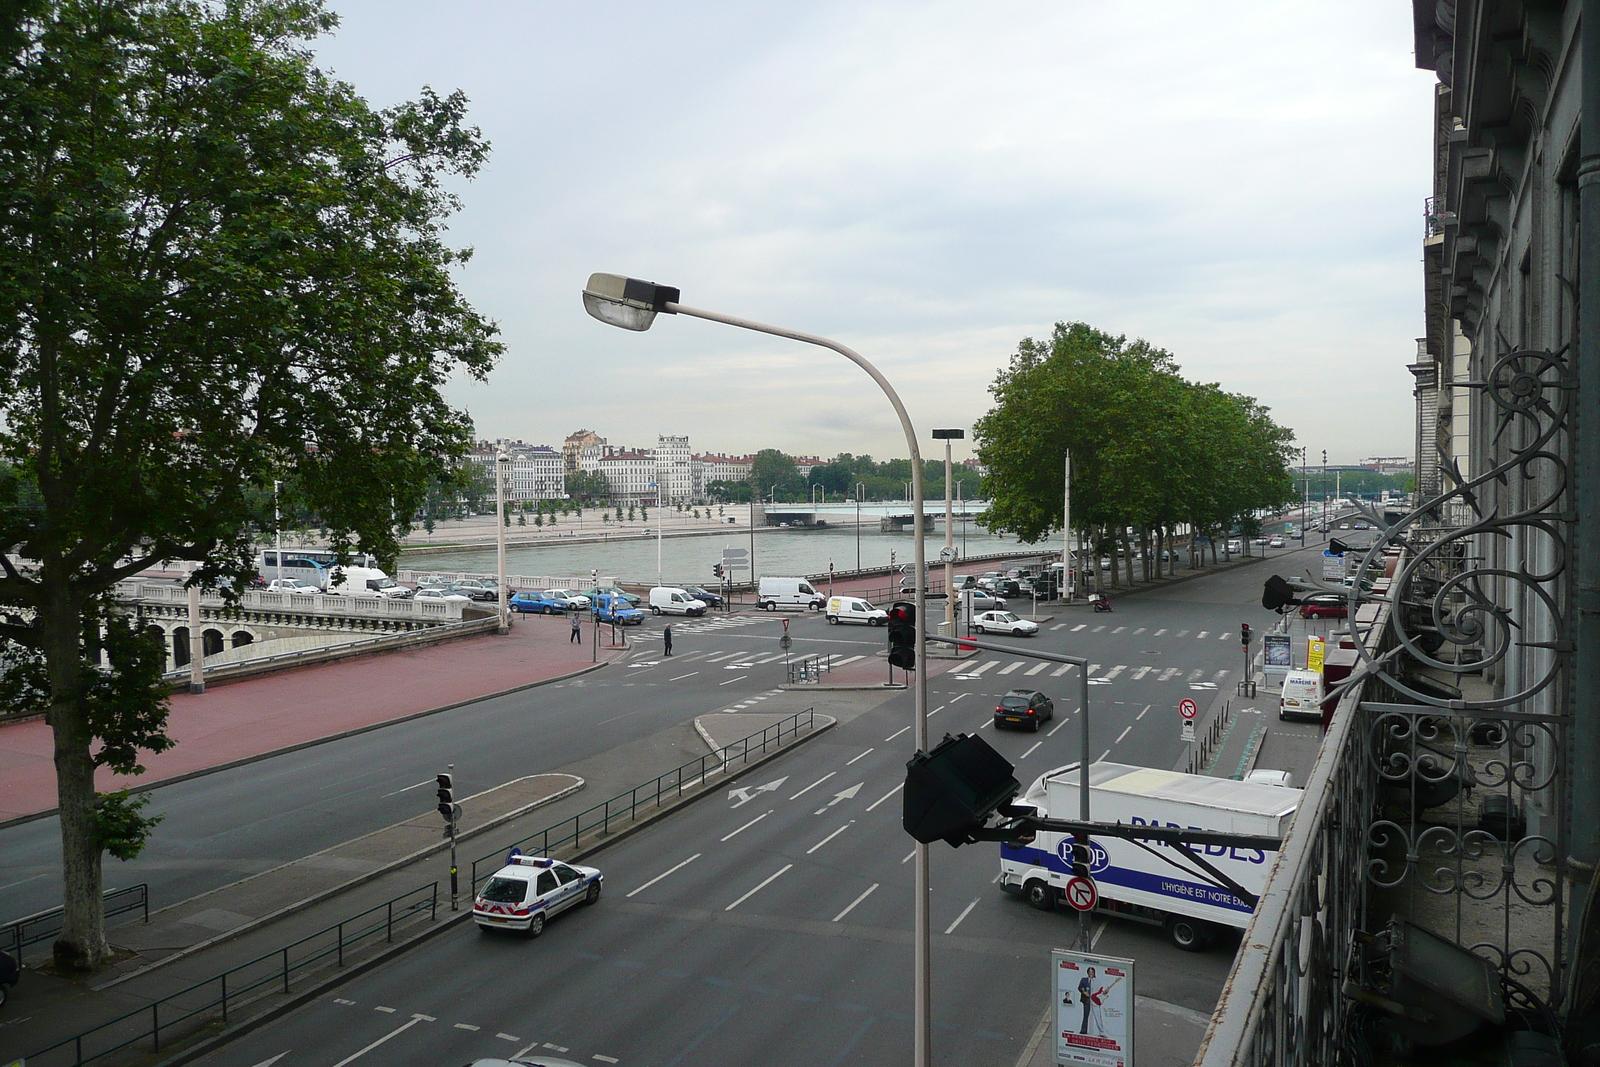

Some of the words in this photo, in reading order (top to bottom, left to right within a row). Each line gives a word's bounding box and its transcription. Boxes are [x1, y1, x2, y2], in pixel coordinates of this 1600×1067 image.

[1161, 881, 1194, 895] L'HYGIÈNE
[1195, 888, 1206, 898] EST
[1208, 890, 1232, 904] NOTRE
